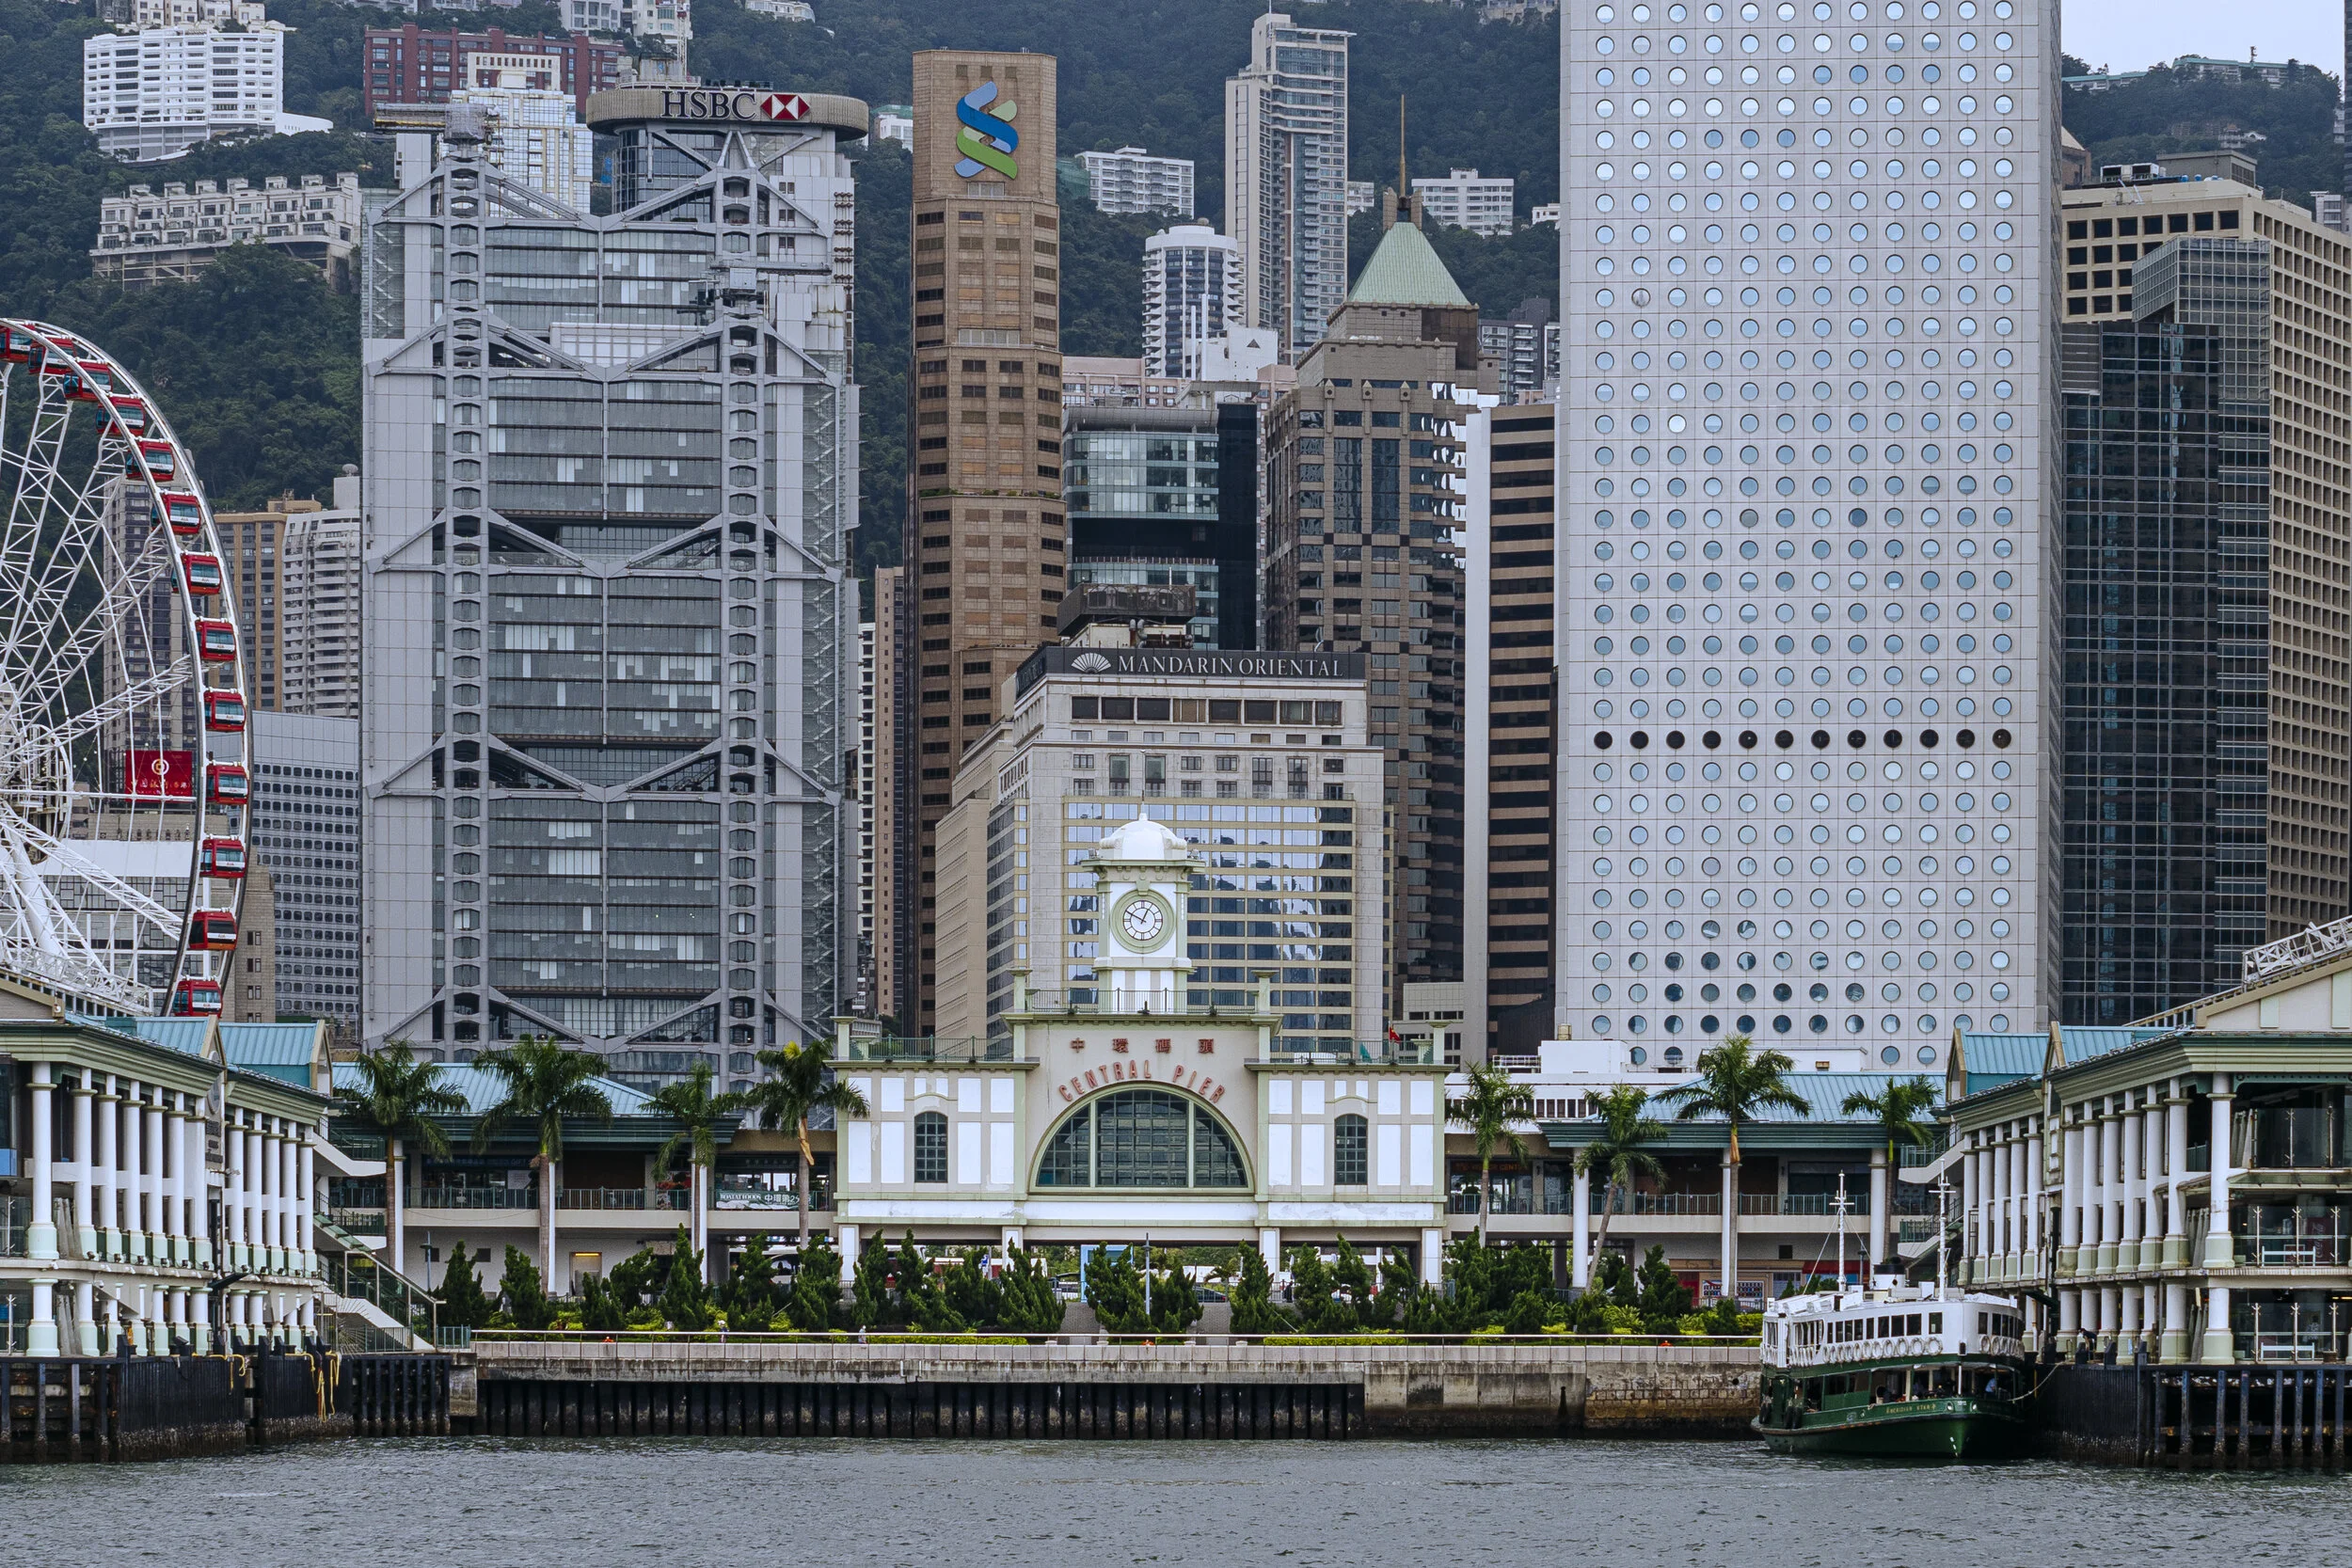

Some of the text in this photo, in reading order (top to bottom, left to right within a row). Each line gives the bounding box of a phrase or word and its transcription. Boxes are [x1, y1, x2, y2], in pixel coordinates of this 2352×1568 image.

[660, 89, 757, 120] HSBC
[1118, 655, 1343, 677] MANDARIN ORIENTAL
[1070, 1037, 1215, 1054] 中環碼頭
[1058, 1059, 1225, 1103] CENTRAL PIER
